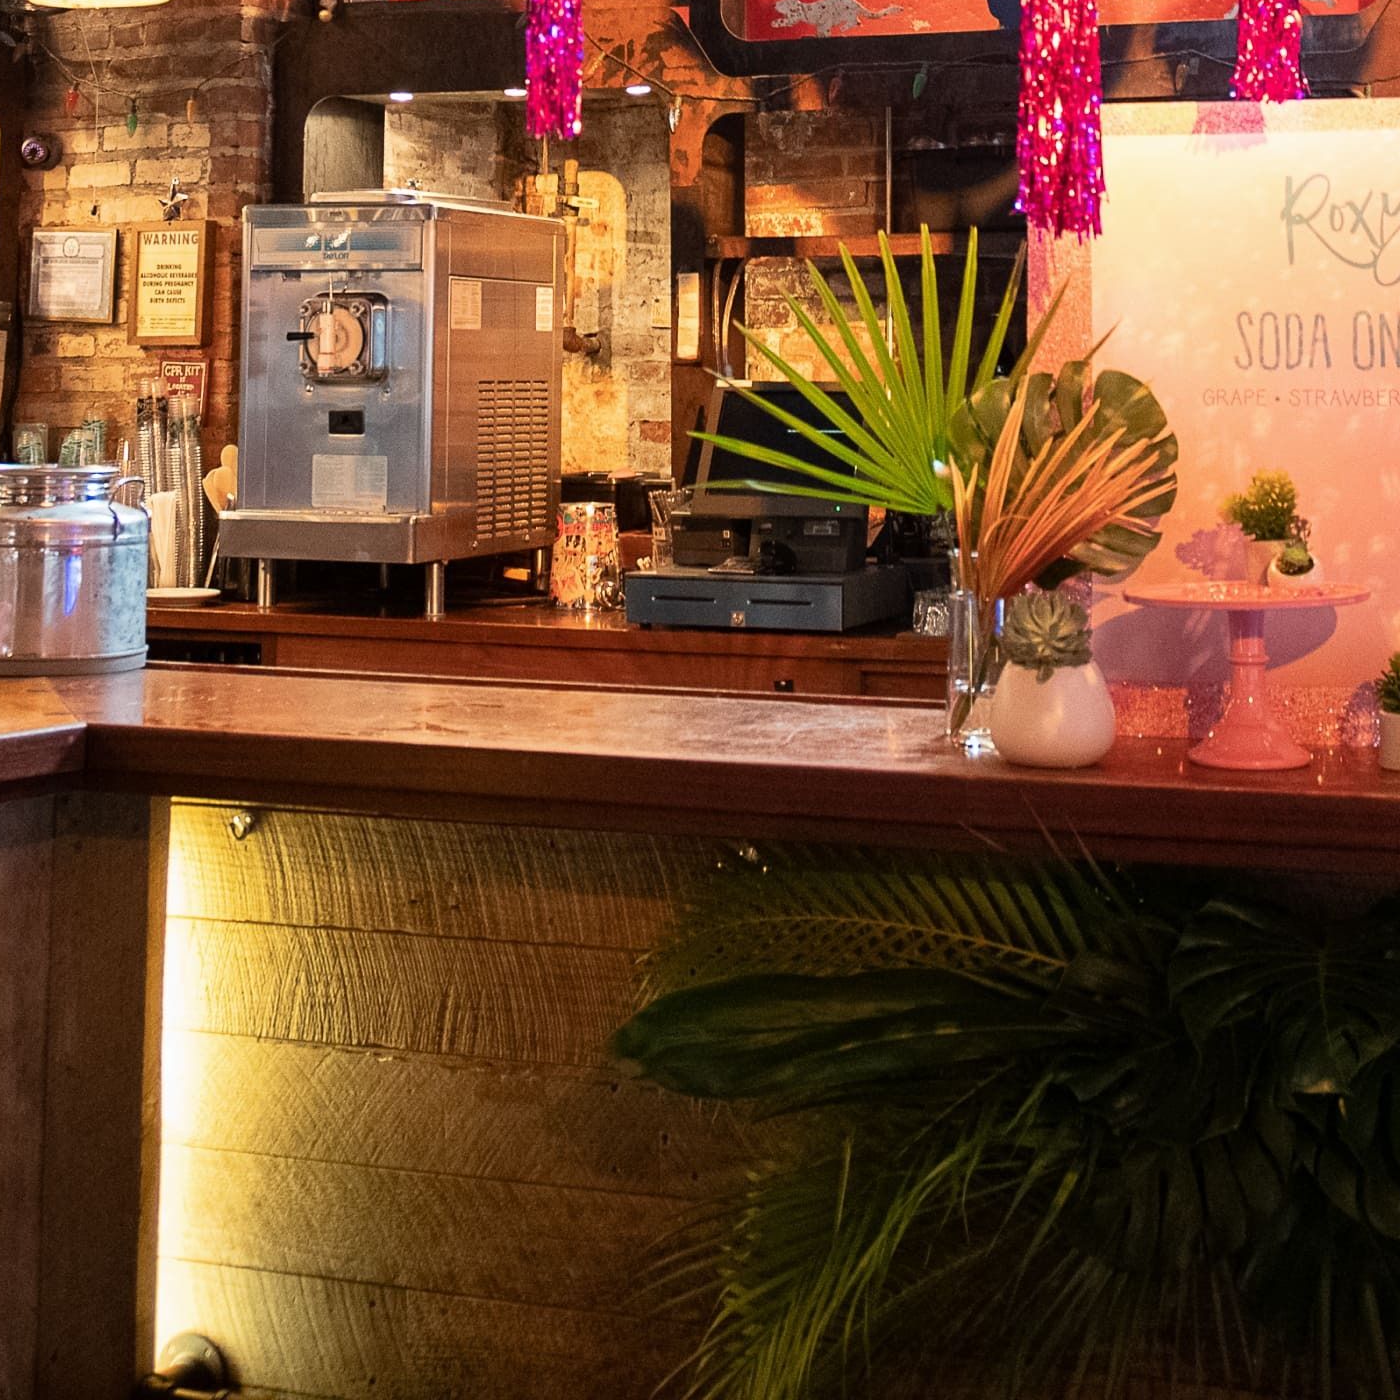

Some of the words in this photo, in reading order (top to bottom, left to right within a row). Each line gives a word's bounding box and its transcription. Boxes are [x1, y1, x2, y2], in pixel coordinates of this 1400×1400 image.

[143, 233, 199, 245] WARNING
[1234, 310, 1332, 371] SODA
[164, 365, 184, 377] CPR
[184, 365, 201, 377] KIT
[1202, 388, 1267, 407] GRAPE
